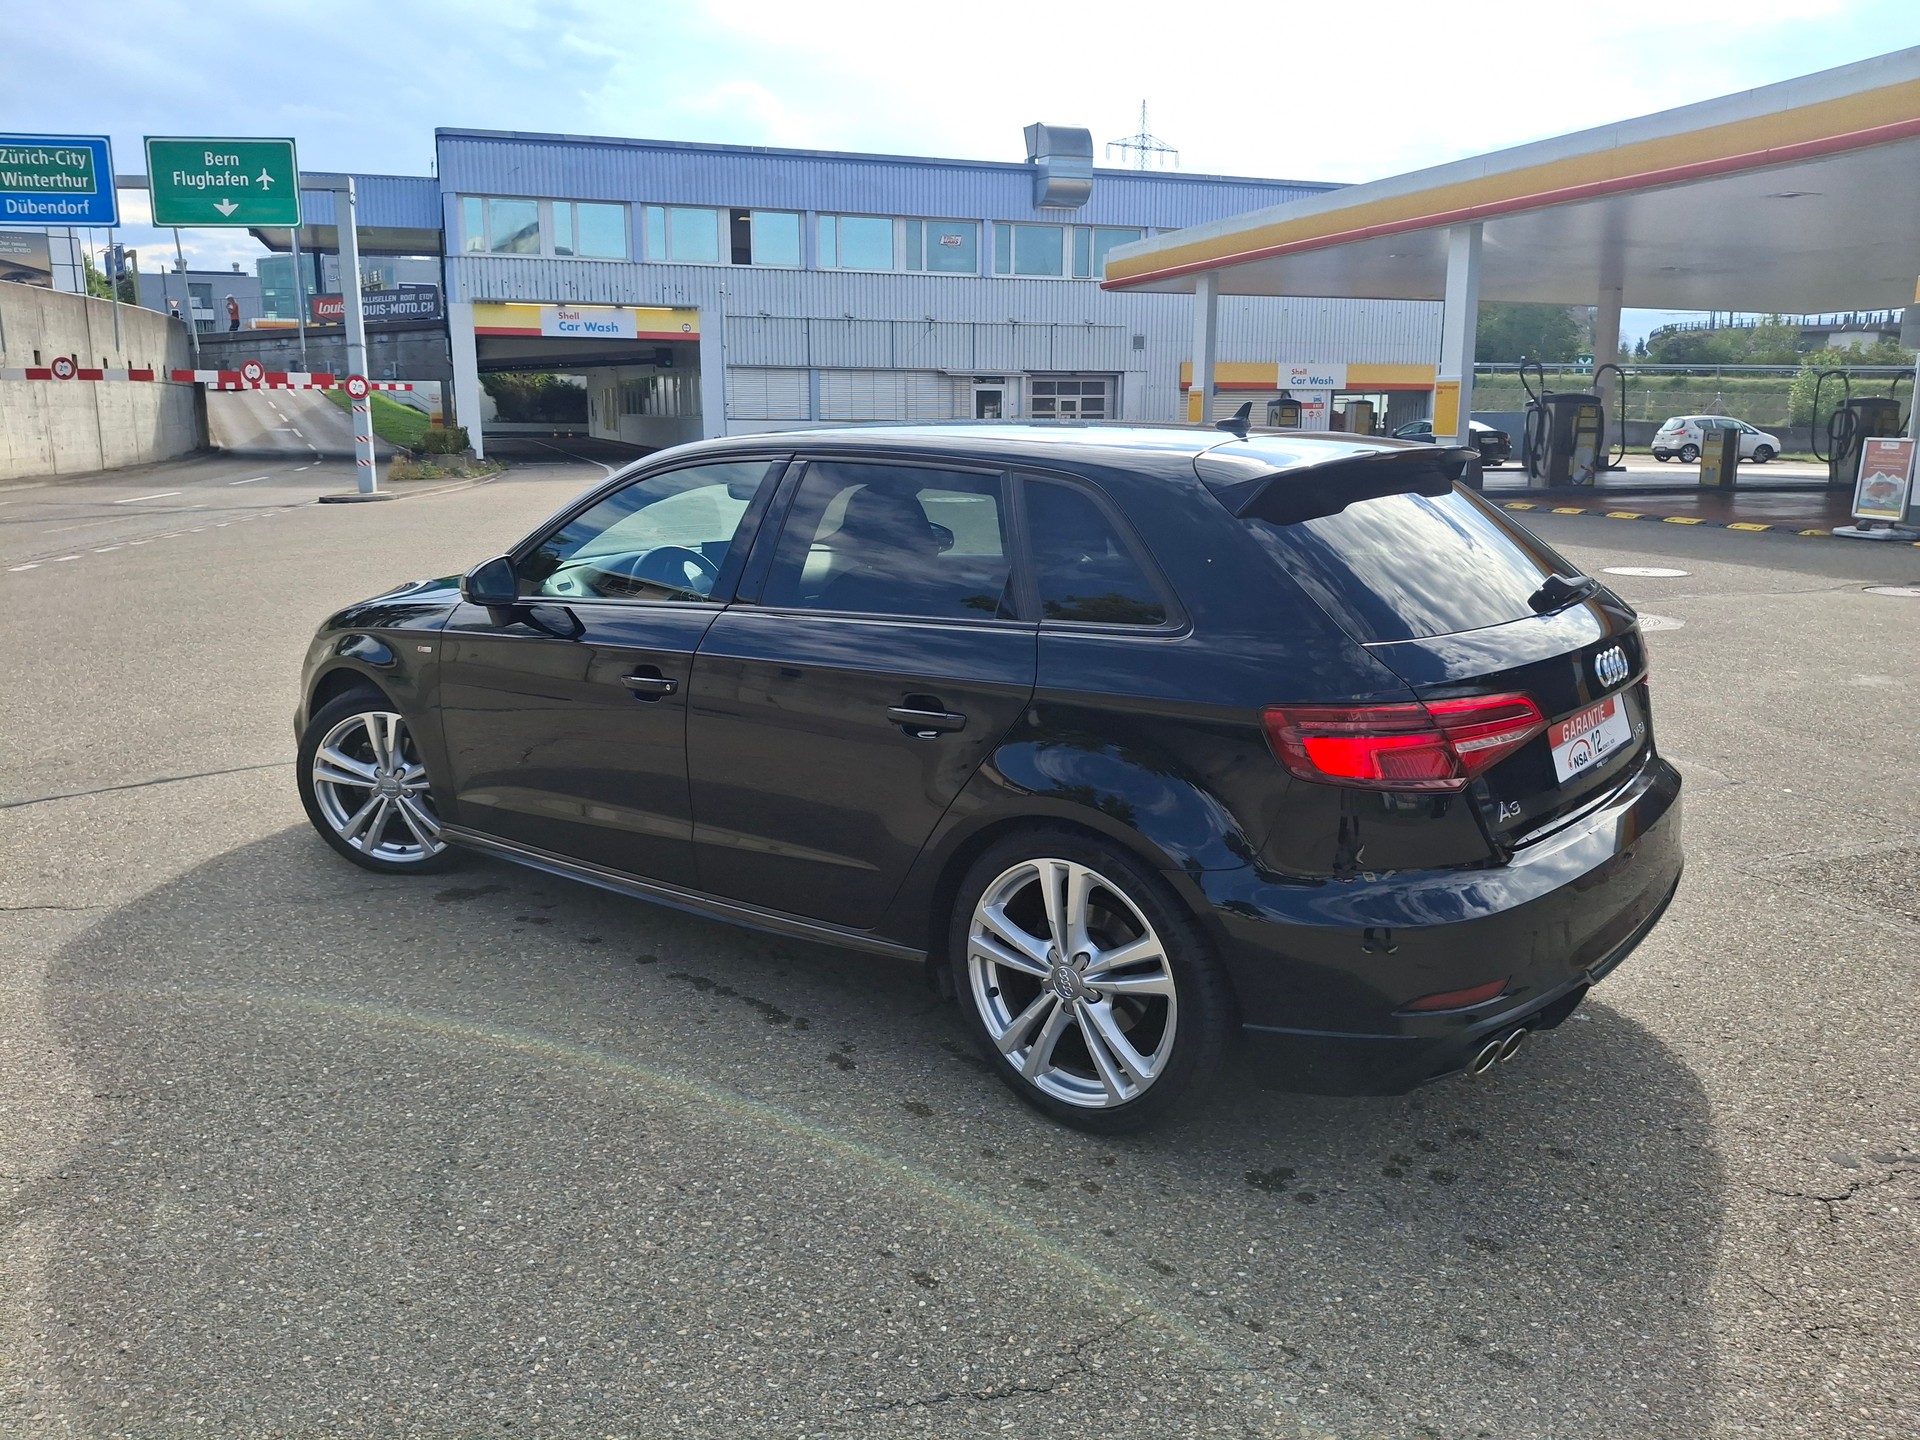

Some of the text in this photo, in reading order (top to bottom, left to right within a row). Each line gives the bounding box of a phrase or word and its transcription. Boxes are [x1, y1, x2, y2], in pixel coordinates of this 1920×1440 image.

[0, 148, 86, 170] Zürich-City
[204, 151, 240, 166] Bern
[1, 171, 89, 188] Winterthur
[172, 170, 249, 190] Flughafen
[5, 198, 90, 215] Dübendorf
[362, 294, 397, 304] ALLISELLEN
[318, 301, 345, 315] Louis
[363, 301, 435, 316] OUIS-MOTO.CH
[558, 311, 580, 321] Shell
[558, 321, 619, 333] Car Wash
[1291, 368, 1308, 376] Shell
[1290, 375, 1334, 385] Car Wash
[1562, 703, 1606, 742] GARANTIE
[1573, 751, 1589, 769] NSA
[1590, 729, 1603, 755] 12
[1498, 800, 1521, 824] A3
